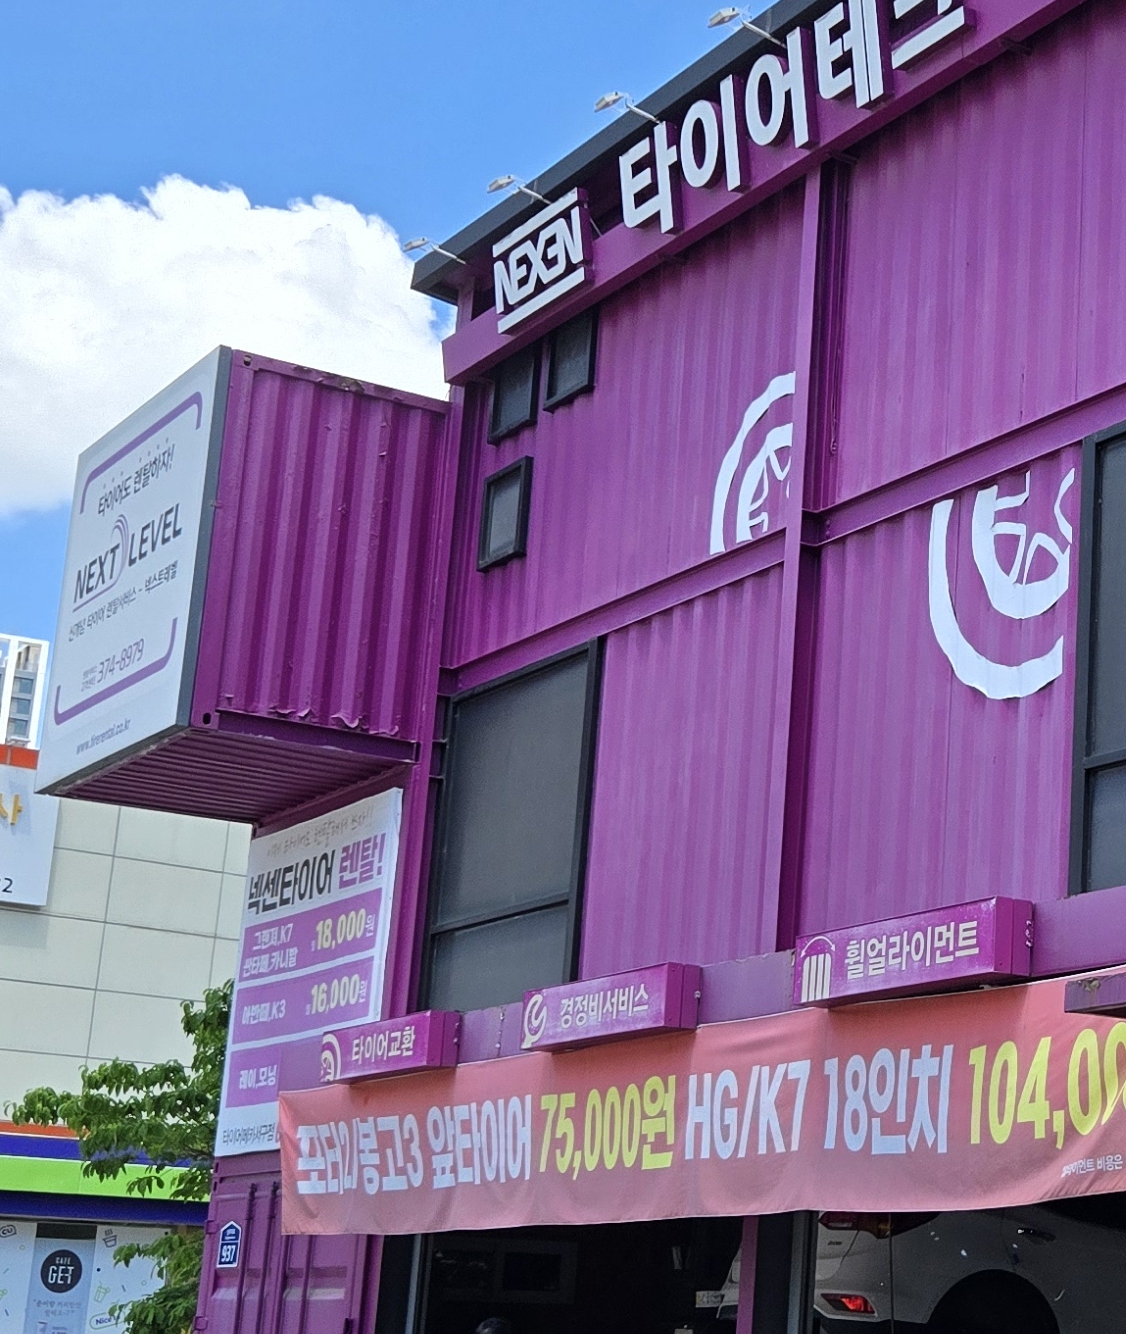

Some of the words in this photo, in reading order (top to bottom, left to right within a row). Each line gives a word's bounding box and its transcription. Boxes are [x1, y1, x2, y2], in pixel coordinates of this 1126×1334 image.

[493, 204, 585, 315] NEXEN
[98, 475, 133, 517] 타이어도
[133, 443, 175, 495] 렌탈하자!
[73, 542, 121, 604] NEXT
[128, 502, 183, 568] LEVEL
[97, 637, 145, 684] 374-8979
[247, 849, 337, 915] 넥센타이어
[338, 832, 386, 890] 렌탈!
[315, 908, 375, 951] 18,000원
[844, 920, 980, 982] 휠얼라이먼트
[310, 973, 368, 1015] 16,000원
[559, 982, 649, 1030] 경정비서비스
[351, 1023, 416, 1065] 타이어교환
[296, 1113, 425, 1195] 포터2/봉고3
[426, 1093, 533, 1190] 앞타이어
[538, 1074, 677, 1181] 75,000원
[684, 1058, 811, 1161] HG/K7
[823, 1043, 955, 1156] 18인치
[1096, 1153, 1123, 1171] 비용은
[48, 1265, 75, 1285] GET
[55, 1256, 72, 1265] CAFE
[221, 1244, 237, 1263] 937
